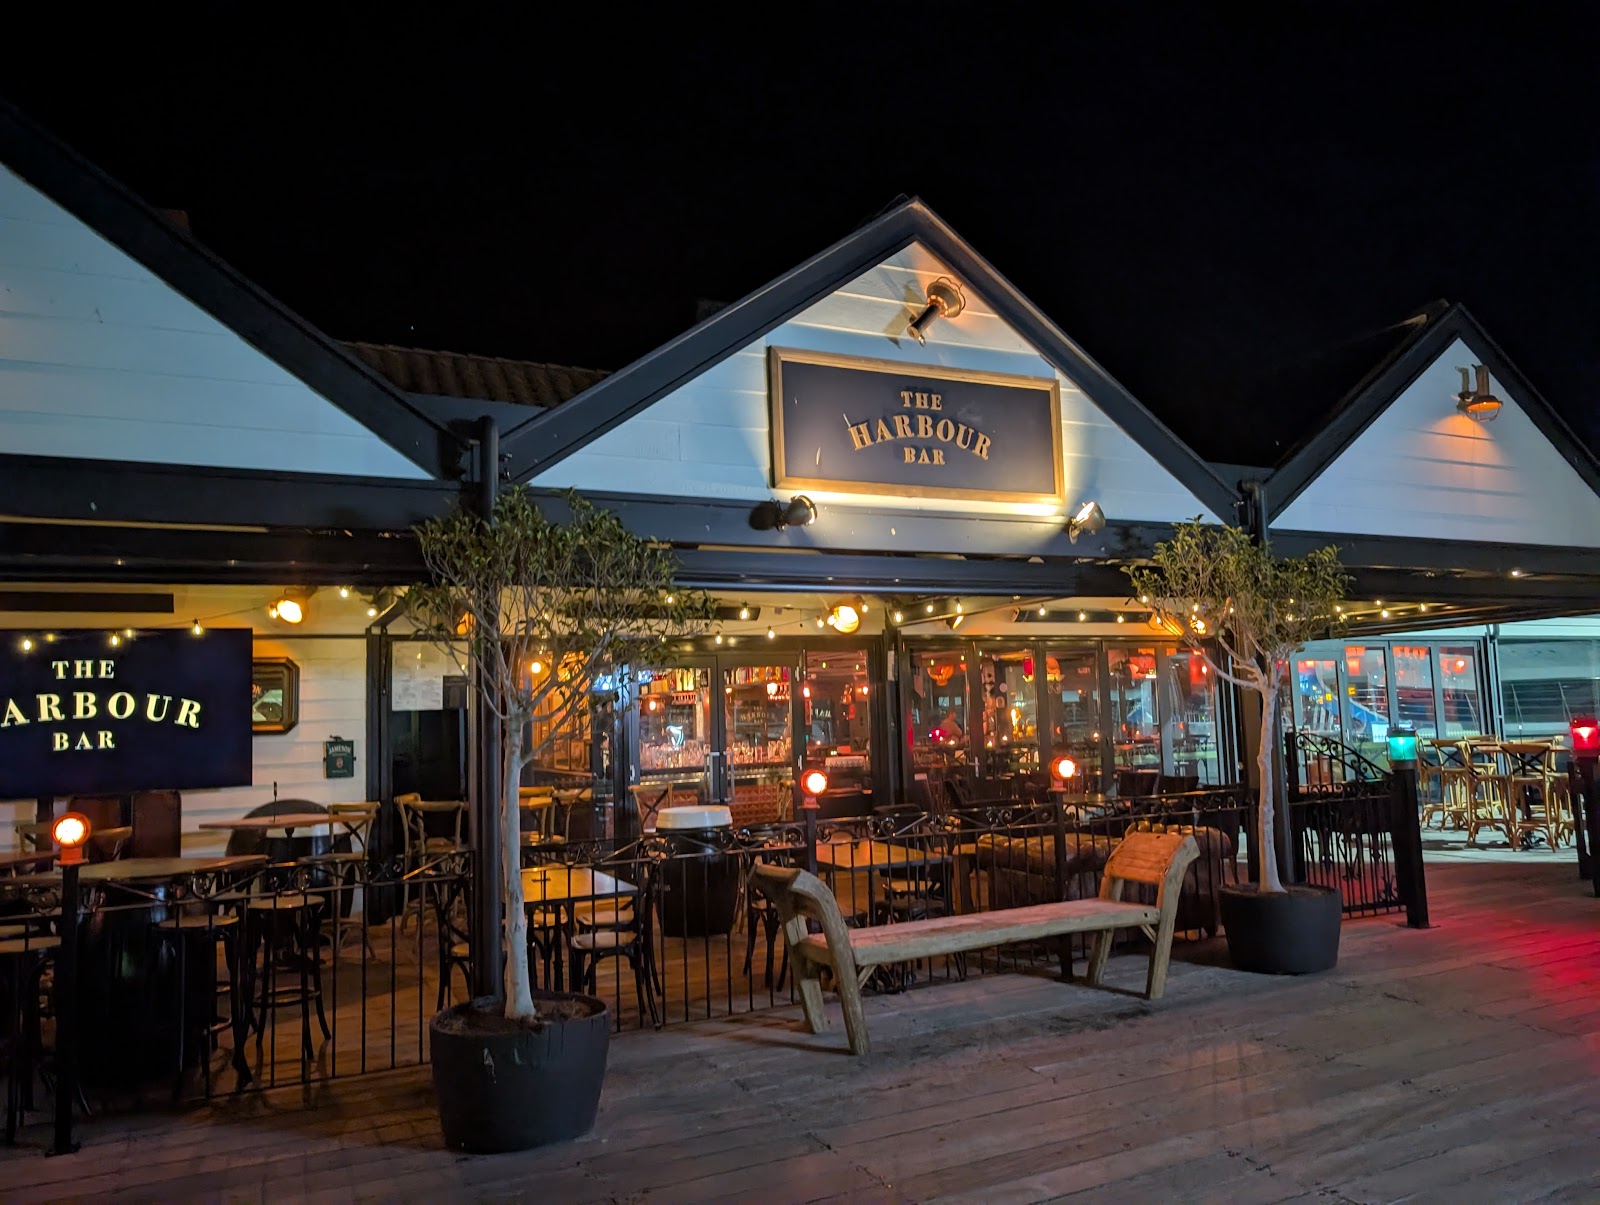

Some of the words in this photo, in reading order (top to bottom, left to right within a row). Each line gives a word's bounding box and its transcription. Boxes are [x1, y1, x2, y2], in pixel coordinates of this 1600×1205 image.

[900, 391, 943, 411] THE
[848, 414, 992, 461] HARBOUR
[903, 447, 946, 465] BAR
[52, 660, 115, 680] THE
[0, 691, 201, 729] ARBOUR
[53, 730, 115, 752] BAR
